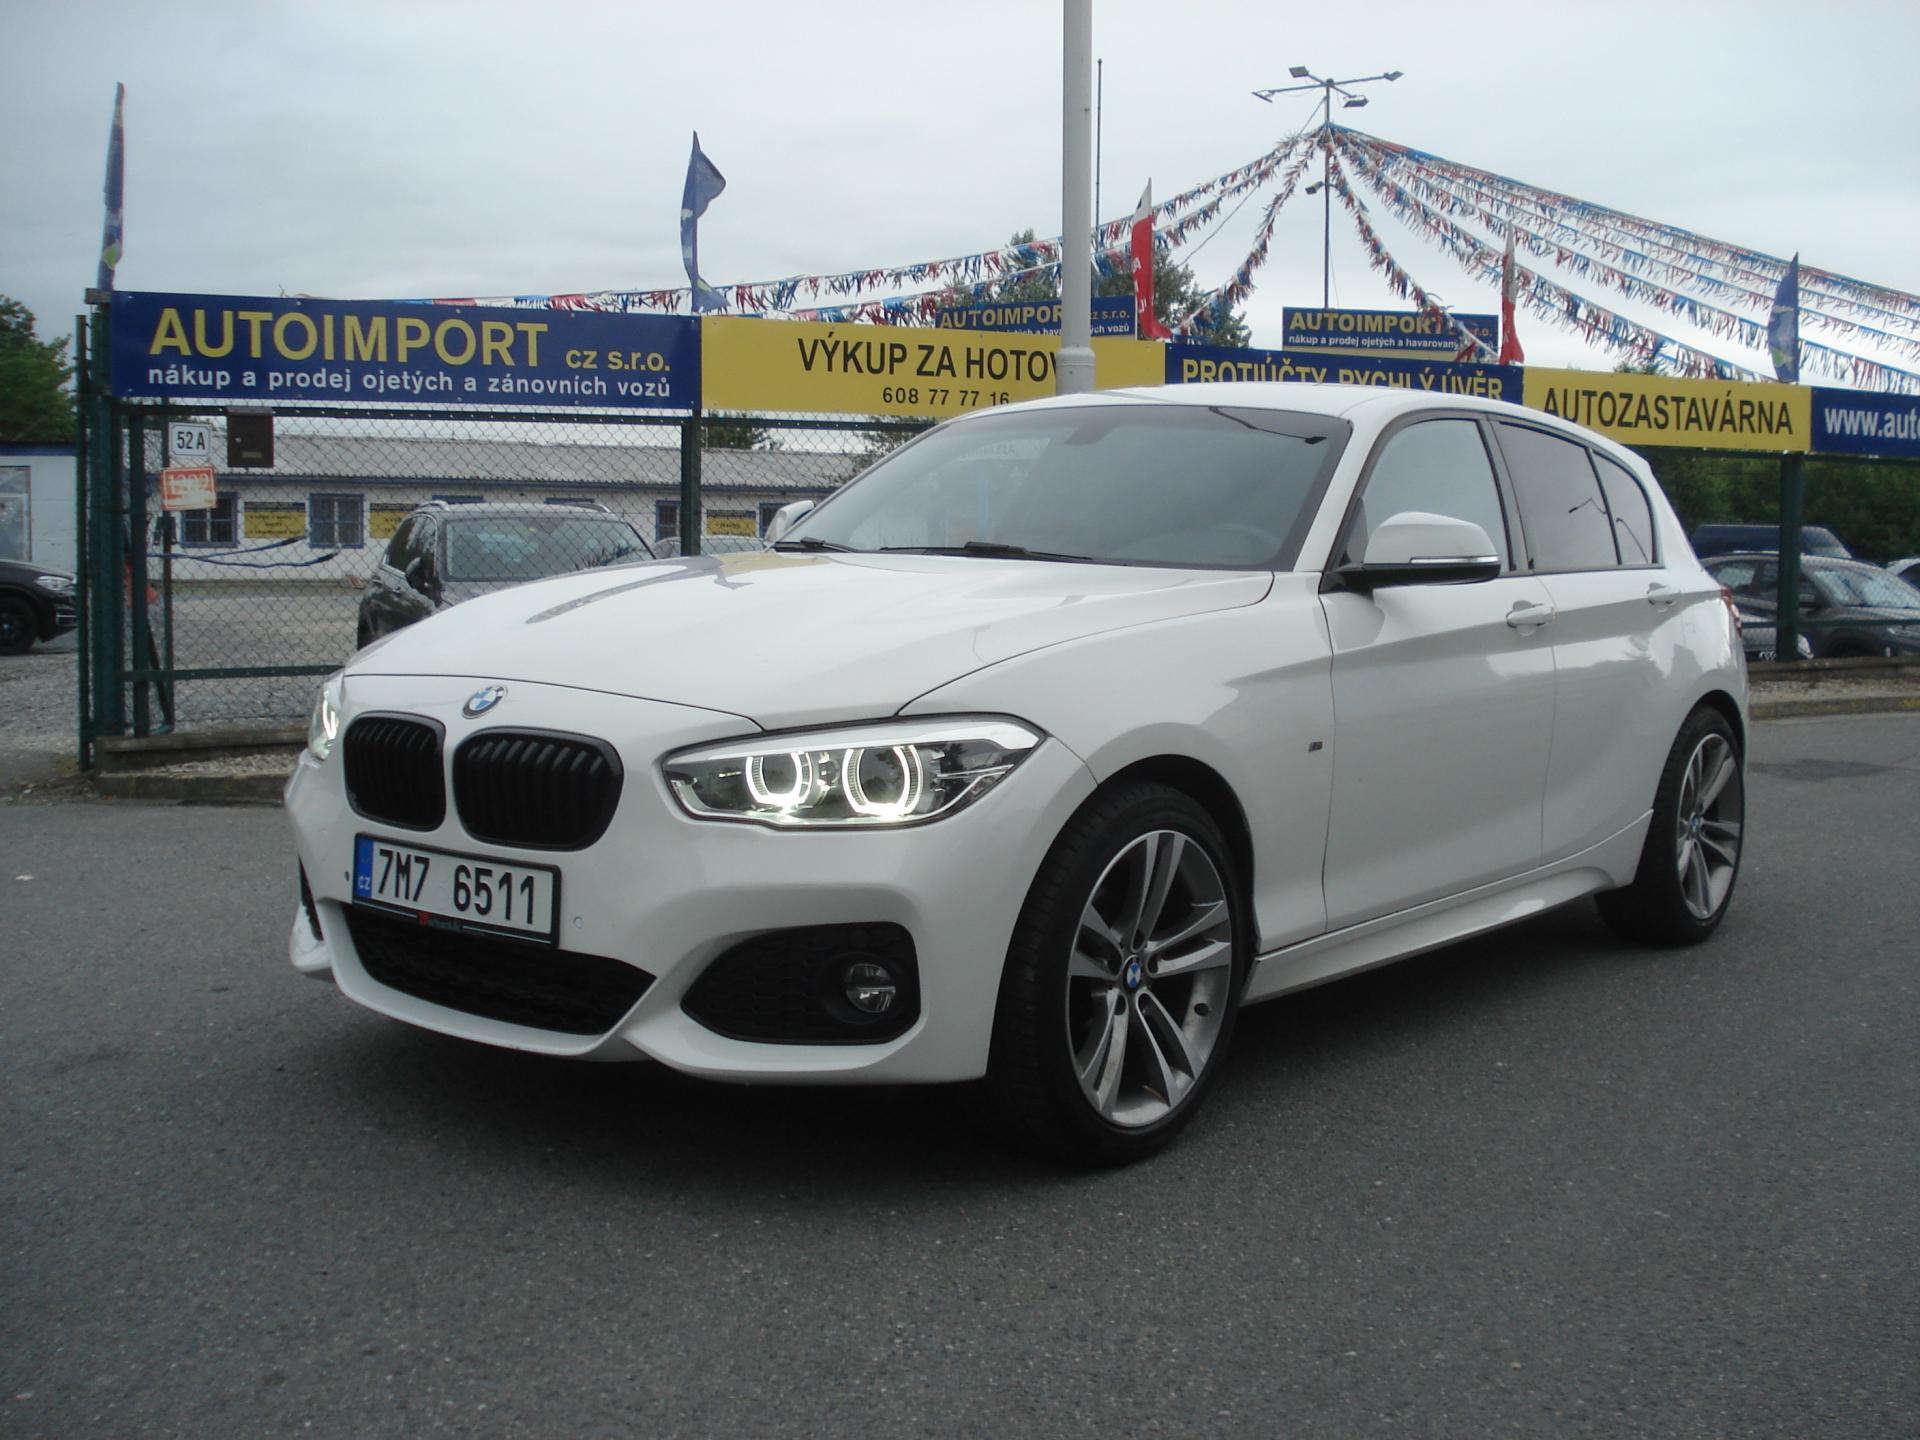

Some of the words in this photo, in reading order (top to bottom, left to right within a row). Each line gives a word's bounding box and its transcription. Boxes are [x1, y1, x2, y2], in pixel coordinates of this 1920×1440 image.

[940, 305, 1062, 329] AUTOIMPOR
[1102, 310, 1130, 320] s.r.o.
[1107, 322, 1130, 333] vozů
[1289, 311, 1443, 335] AUTOIMPORT
[149, 307, 548, 367] AUTOIMPORT
[565, 349, 597, 369] cz
[607, 350, 671, 372] s.r.o.
[1288, 335, 1318, 346] nákup
[1328, 335, 1359, 348] prodej
[1361, 336, 1395, 349] ojetých
[1397, 339, 1404, 347] a
[798, 331, 907, 375] VÝKUP
[916, 344, 957, 378] ZA
[966, 347, 1057, 382] HOTO
[149, 364, 231, 390] nákup
[242, 369, 256, 387] a
[269, 367, 351, 392] prodej
[362, 370, 453, 394] ojetých
[463, 378, 477, 392] a
[488, 372, 607, 396] zánovních
[617, 377, 671, 397] vozů
[1441, 368, 1503, 400] ÚVĚR
[883, 387, 919, 404] 608
[928, 389, 949, 406] 77
[959, 390, 980, 407] 77
[990, 391, 1009, 406] 16
[1543, 387, 1793, 435] AUTOZASTAVÁRNA
[177, 431, 193, 449] 52
[196, 432, 205, 449] A
[357, 876, 371, 891] CZ
[378, 848, 430, 902] 7M7
[454, 864, 534, 924] 6511
